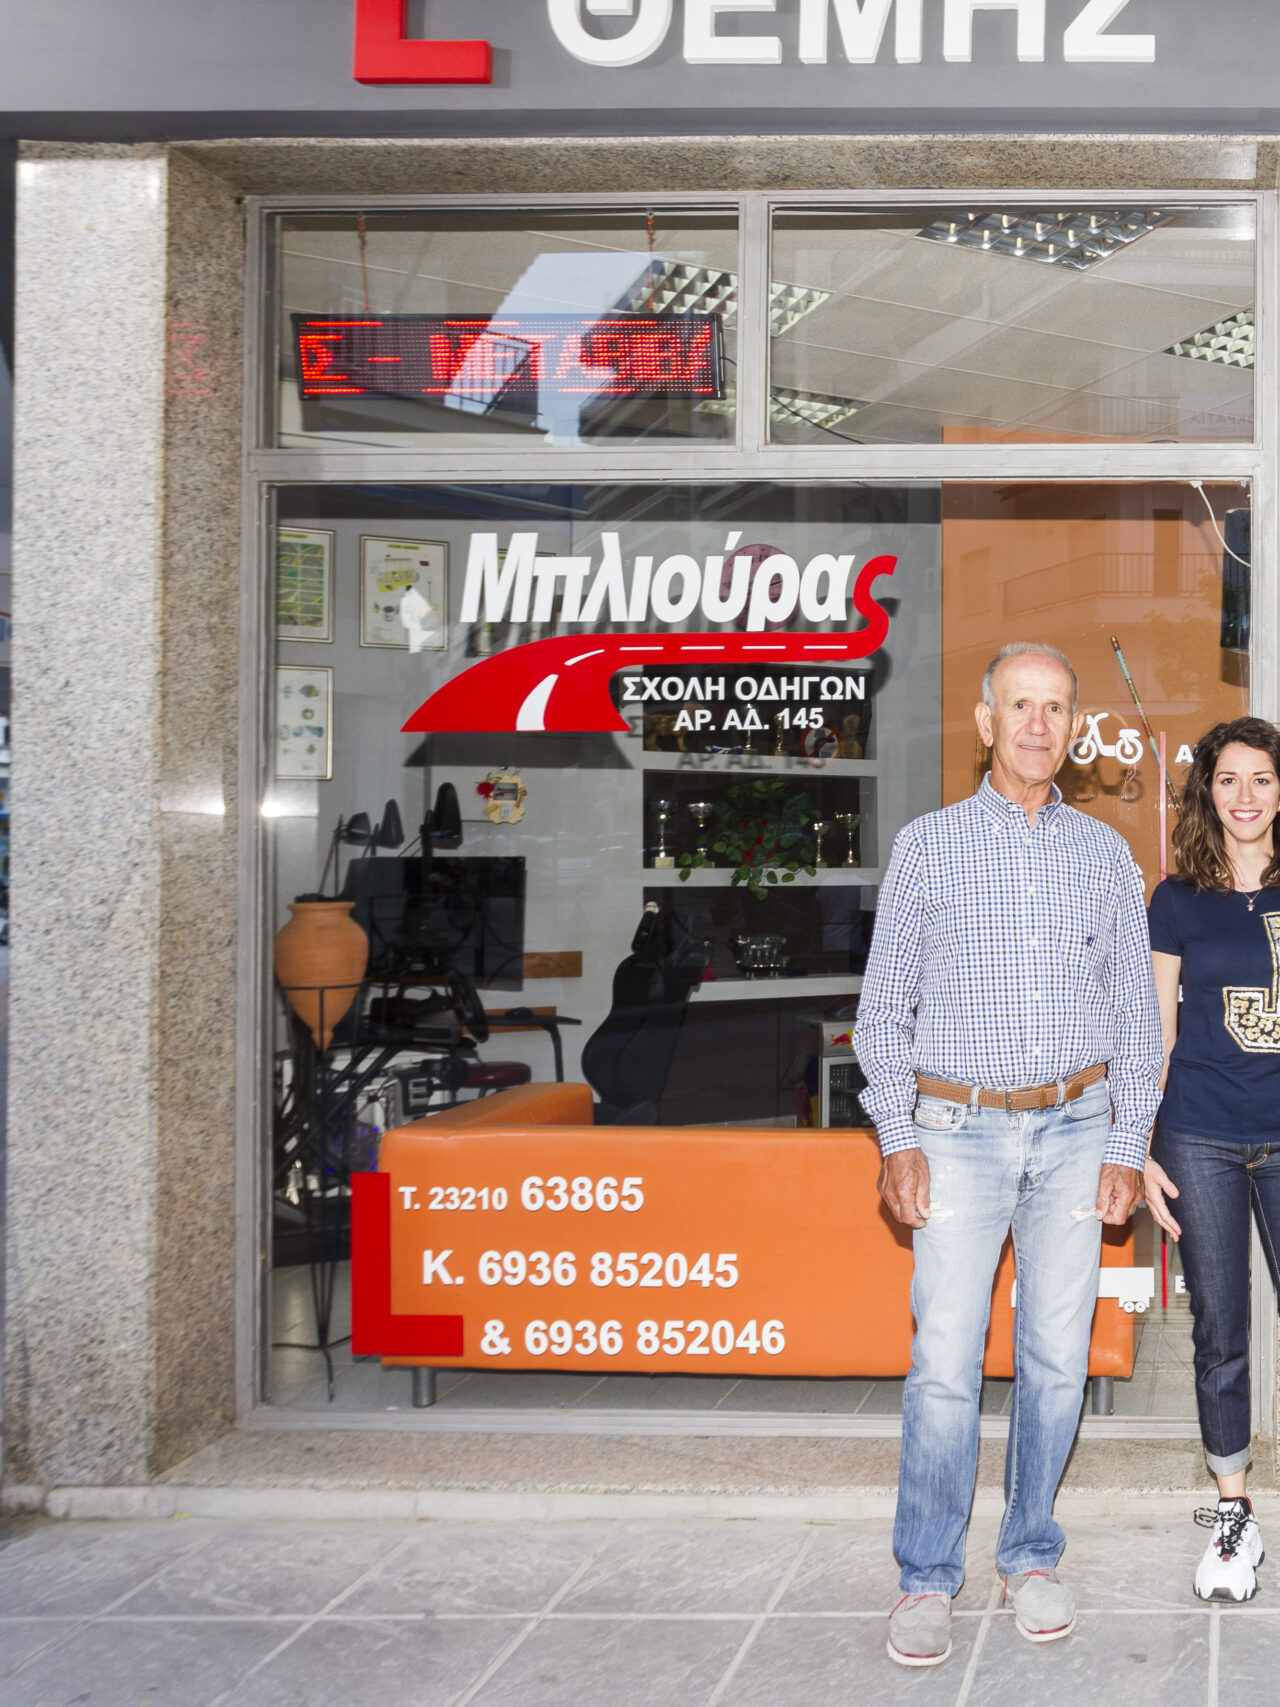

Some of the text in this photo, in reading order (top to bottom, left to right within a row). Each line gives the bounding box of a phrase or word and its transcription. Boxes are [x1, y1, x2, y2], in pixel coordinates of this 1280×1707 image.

[459, 530, 898, 632] Μπλιούρας
[622, 676, 866, 701] ΣΧΟΛΗ ΟΔΗΓΩΝ
[673, 706, 824, 731] ΑΡ. ΑΔ. 145
[428, 1186, 508, 1211] 23210
[520, 1176, 645, 1212] 63865
[478, 1250, 577, 1287] 6936
[590, 1252, 740, 1288] 852045
[480, 1319, 786, 1355] & 6936 852046
